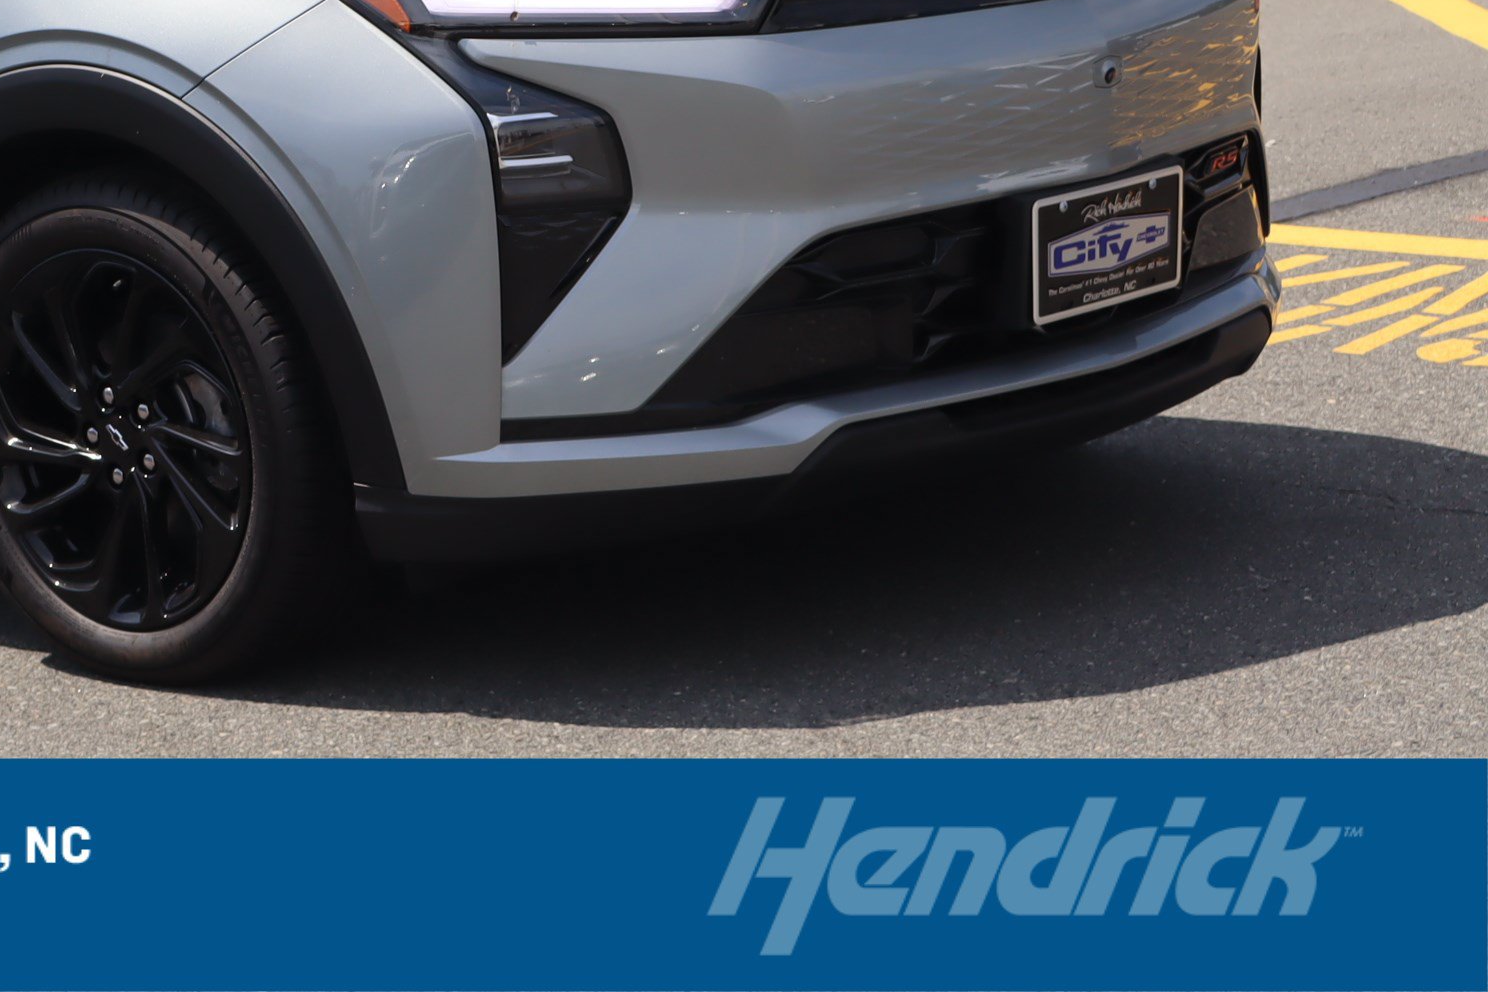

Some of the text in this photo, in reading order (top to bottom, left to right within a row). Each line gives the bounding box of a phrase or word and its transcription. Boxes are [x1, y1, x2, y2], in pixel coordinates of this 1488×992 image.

[1210, 149, 1238, 175] RS
[1053, 233, 1133, 270] City
[1124, 280, 1137, 291] NC
